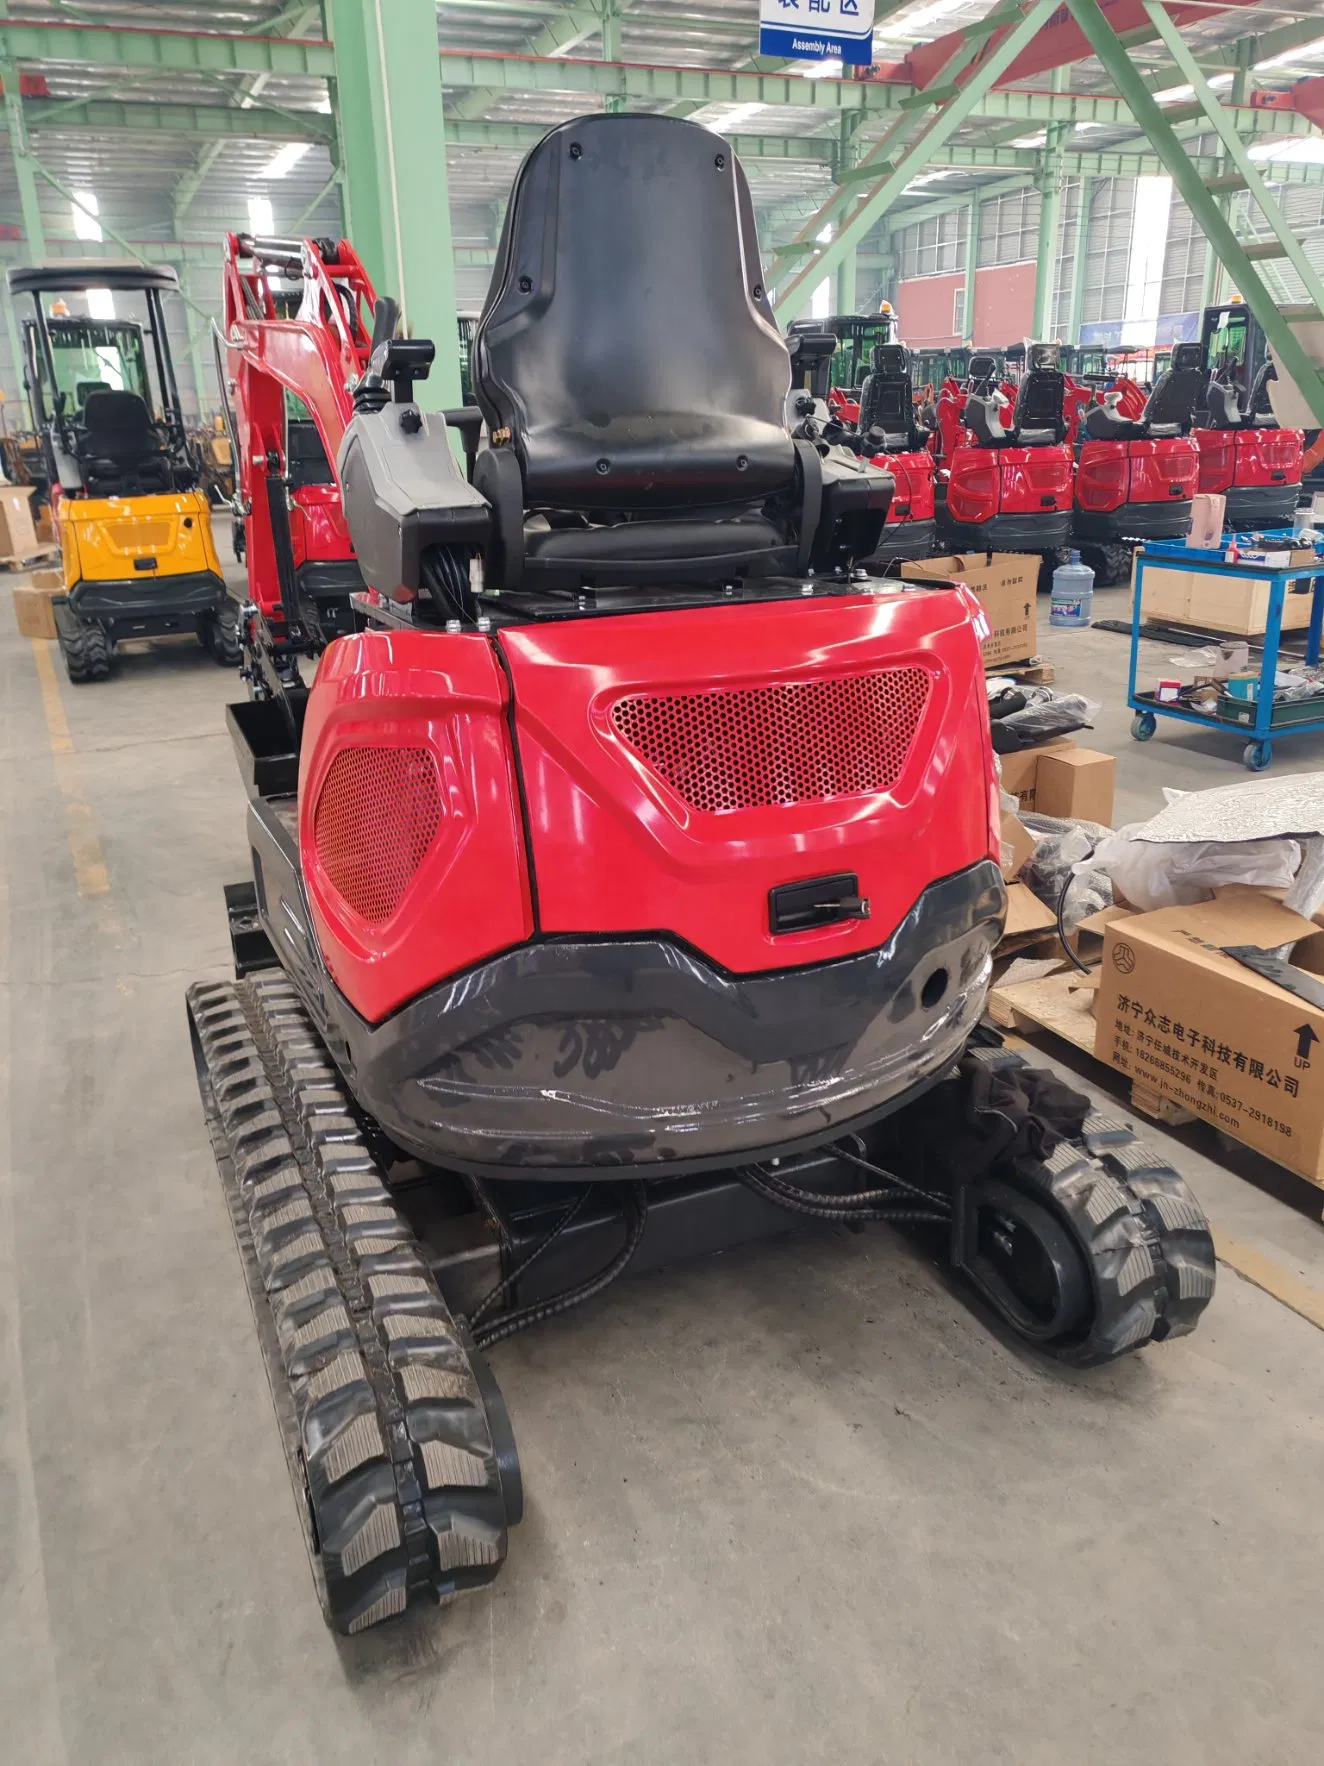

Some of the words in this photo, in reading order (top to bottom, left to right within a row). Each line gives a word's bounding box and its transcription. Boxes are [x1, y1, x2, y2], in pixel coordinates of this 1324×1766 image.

[792, 38, 825, 55] Assembly
[826, 41, 842, 55] Area
[1117, 994, 1300, 1098] 济宁众志电子科技有限公司
[1294, 1057, 1311, 1071] UP
[1134, 1066, 1240, 1129] www.jn-zhongzhi.com
